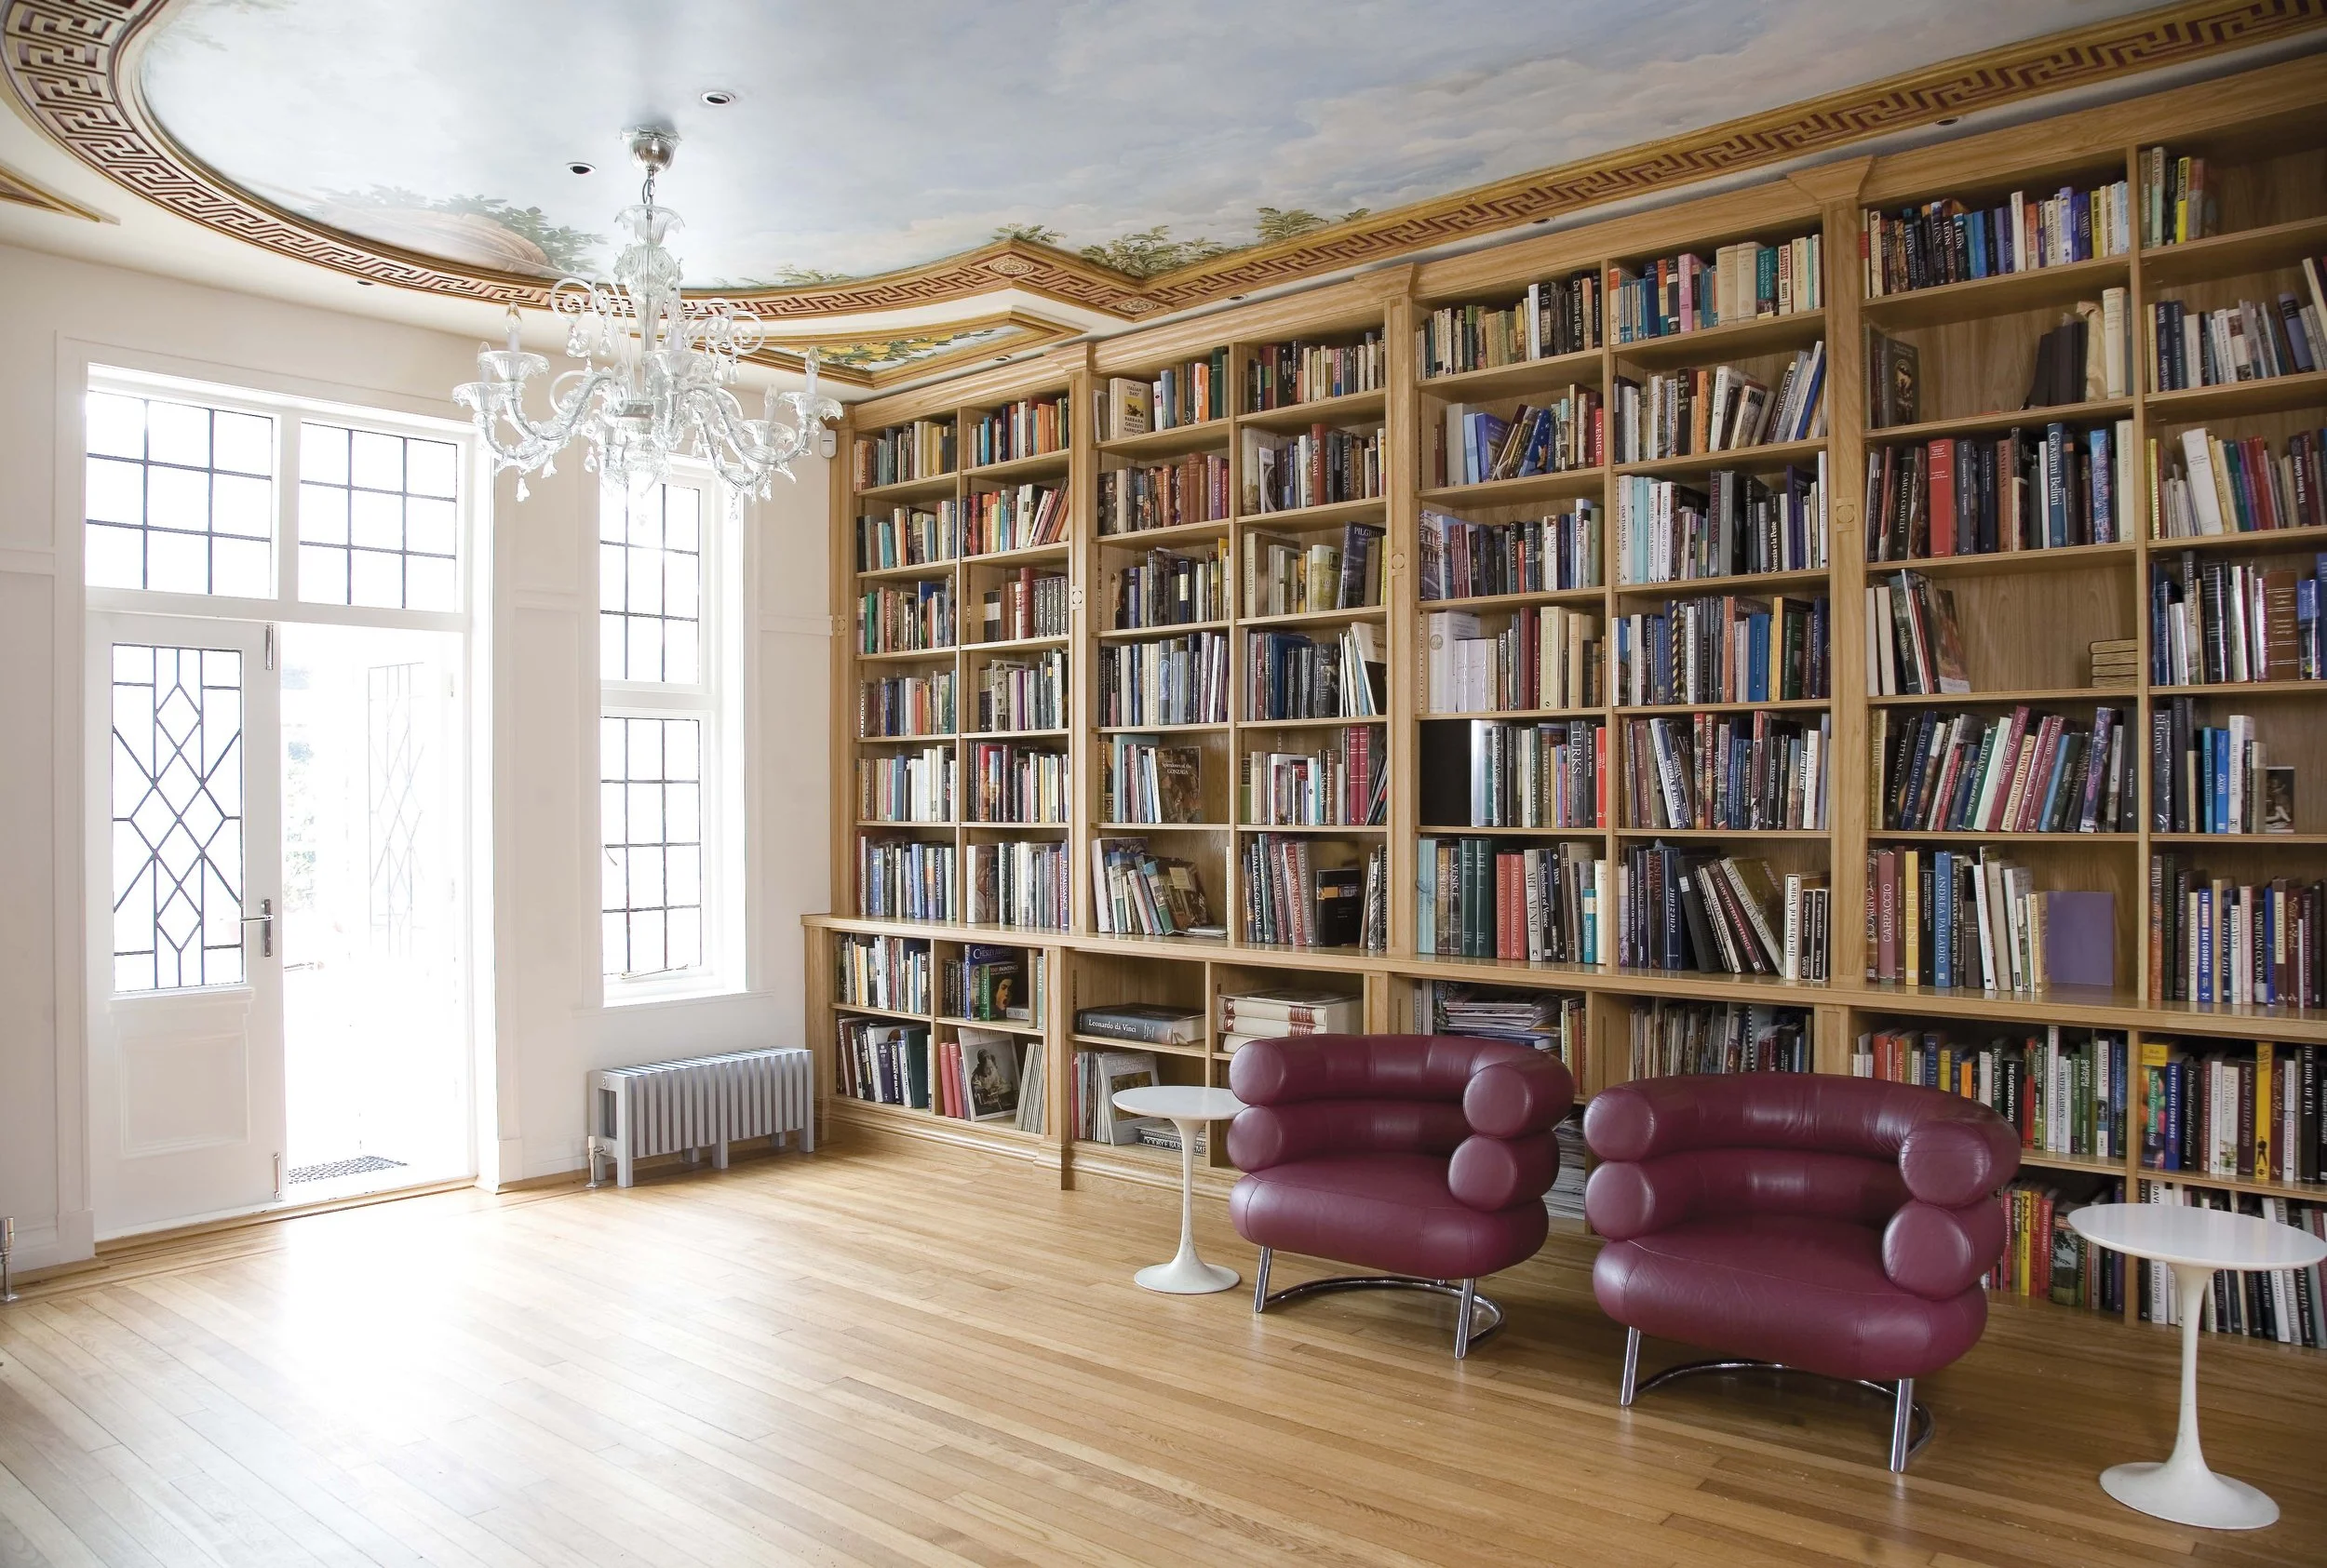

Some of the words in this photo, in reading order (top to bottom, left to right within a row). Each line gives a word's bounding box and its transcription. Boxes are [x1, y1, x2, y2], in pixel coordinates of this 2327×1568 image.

[1904, 229, 1913, 255] LEON
[1943, 221, 1951, 246] LEON
[1780, 248, 1789, 280] GLADSTONE
[1778, 385, 1790, 411] VENETO
[2049, 432, 2061, 475] Giovanni
[2051, 476, 2062, 505] Bellini
[2155, 714, 2165, 724] El
[1494, 734, 1500, 743] An
[1571, 728, 1581, 774] TURKS
[1917, 734, 1927, 749] THE
[2046, 721, 2060, 755] Tintoretto
[2155, 727, 2166, 754] Greco
[1896, 739, 1906, 771] TITIAN
[1978, 744, 1988, 771] TITIAN
[2006, 742, 2015, 763] Titian's
[1914, 769, 1920, 778] OF
[1999, 763, 2012, 784] Women
[2015, 749, 2031, 785] Venetian
[1907, 781, 1918, 806] TITIAN
[1527, 871, 1536, 887] ART
[2152, 867, 2162, 889] ITALY
[1254, 893, 1259, 905] OF
[1288, 854, 1298, 891] UNKNOWN
[1293, 895, 1301, 933] LEONARDO
[1304, 889, 1308, 898] DA
[1726, 866, 1740, 890] VILLAS
[1742, 898, 1754, 913] THE
[1749, 913, 1767, 940] VENETO
[1788, 880, 1797, 909] Venice
[1528, 898, 1539, 936] VENICE
[1715, 878, 1724, 895] GRAN
[1725, 895, 1735, 918] TEATRO
[1739, 928, 1751, 950] FENICE
[1788, 911, 1796, 920] of
[1866, 888, 1876, 941] CARPACCIO
[1883, 884, 1891, 942] CARPACCIO
[1906, 891, 1916, 946] BELLINI
[1787, 920, 1796, 947] Orient
[1088, 1019, 1114, 1031] Leonardo
[1123, 1023, 1137, 1033] Vinci
[2305, 1064, 2313, 1084] BOOK
[2305, 1088, 2312, 1097] OF
[2305, 1101, 2313, 1115] TEA
